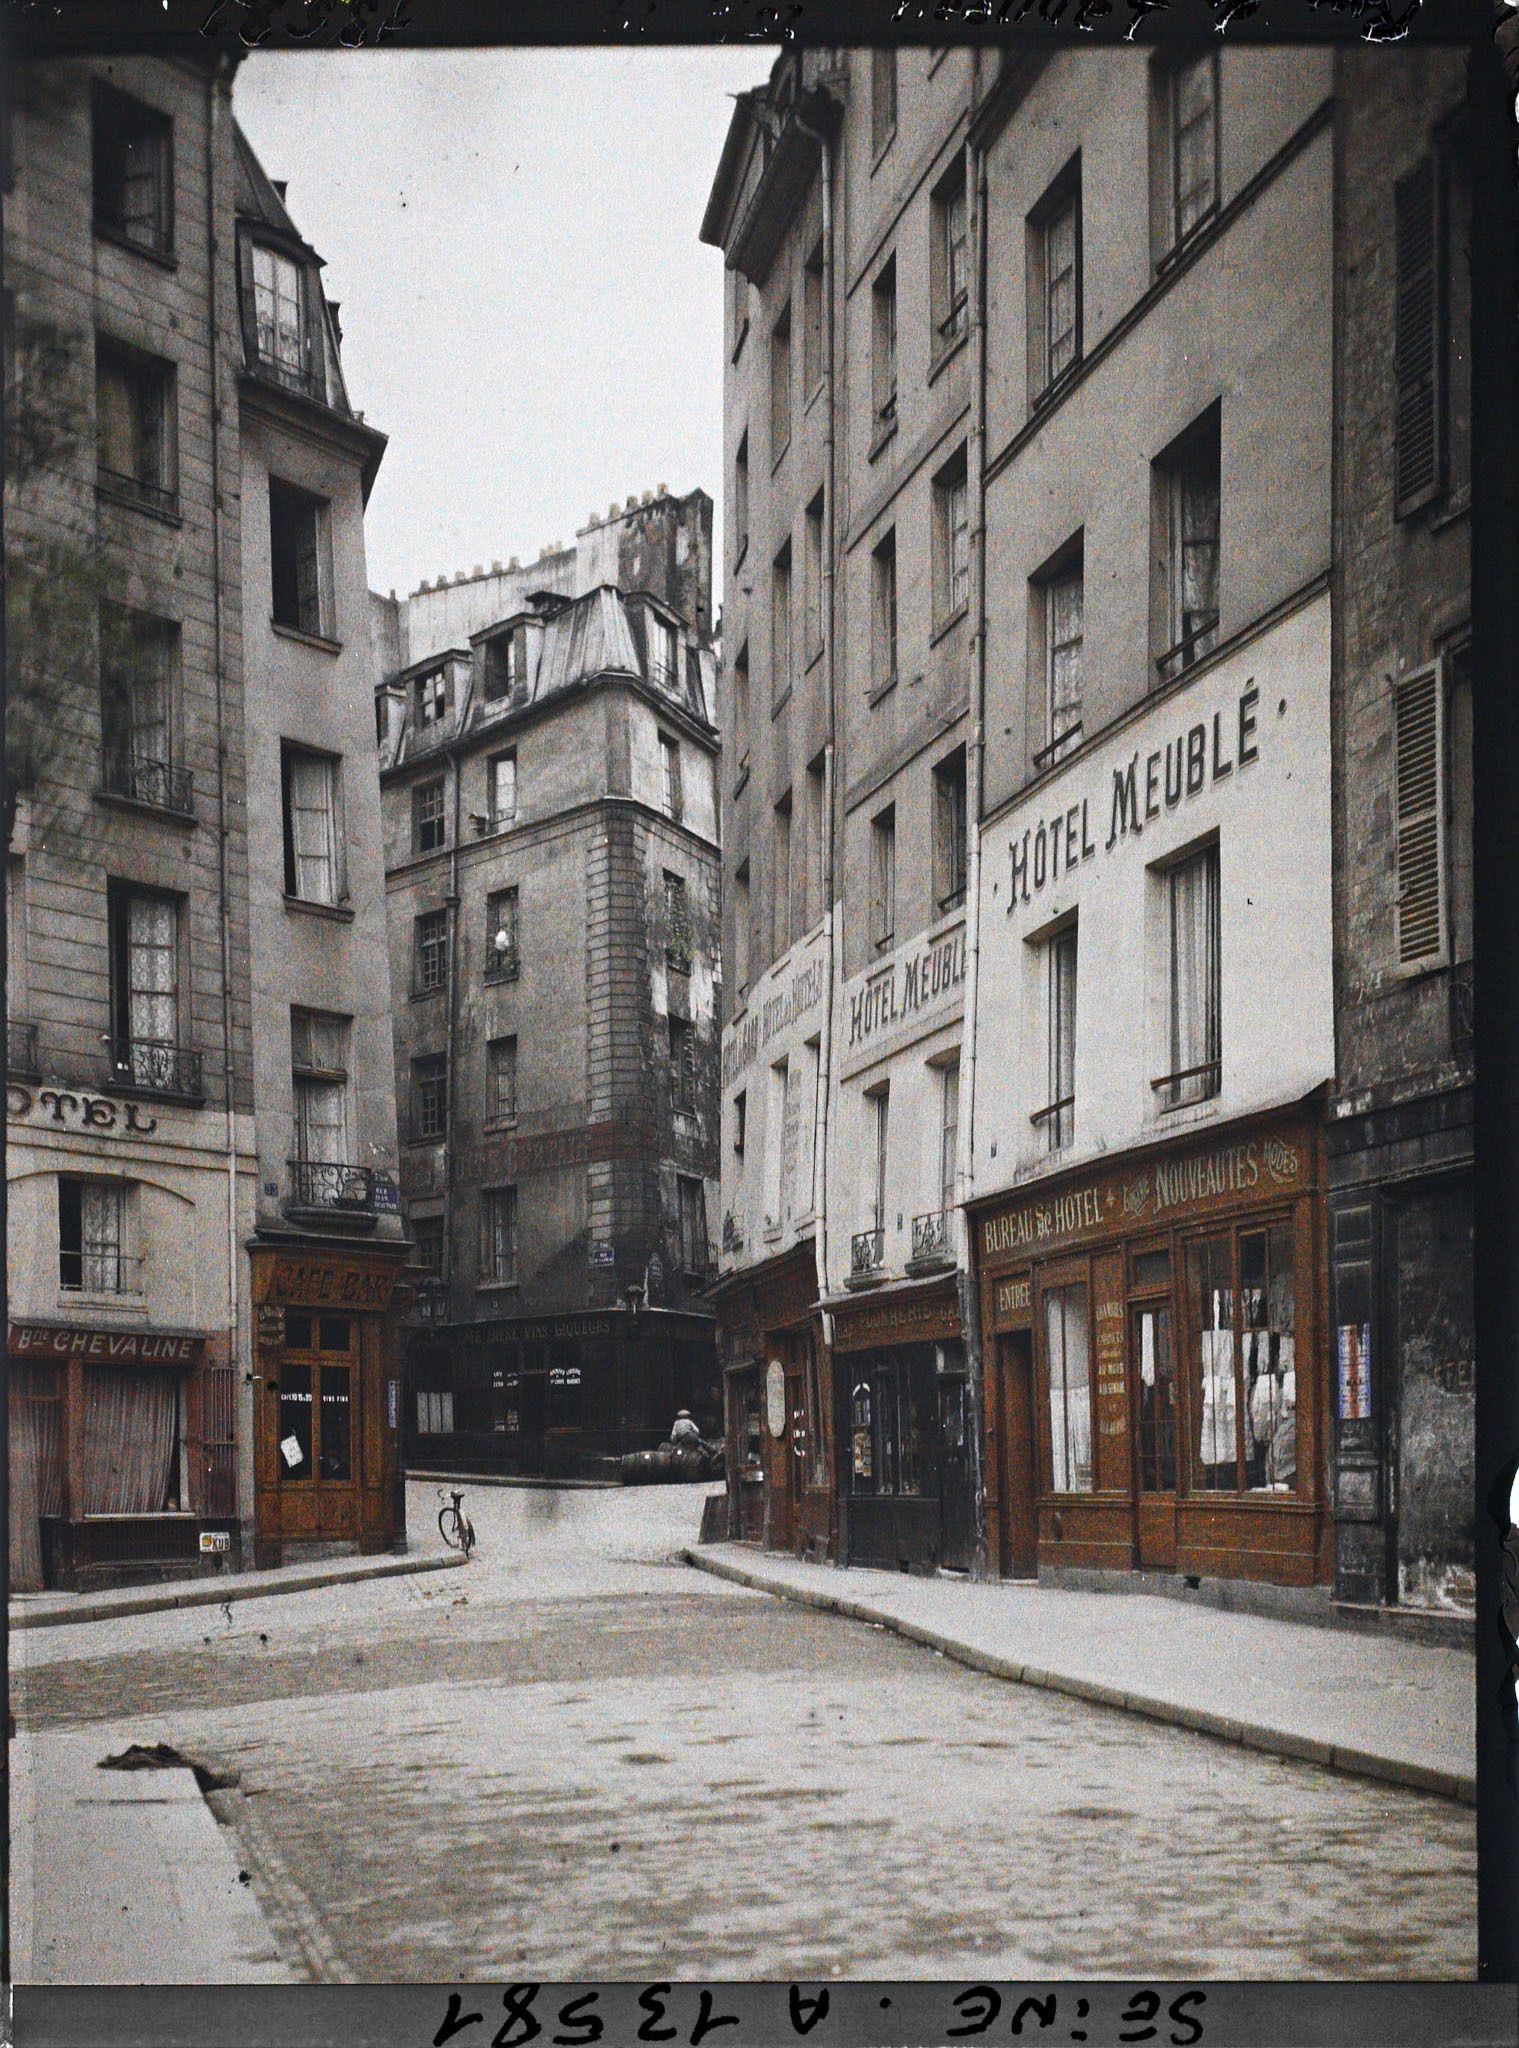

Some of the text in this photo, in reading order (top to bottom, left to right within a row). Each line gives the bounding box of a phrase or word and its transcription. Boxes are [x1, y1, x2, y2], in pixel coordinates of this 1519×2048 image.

[1006, 677, 1260, 914] HÔTEL MEUBLÉ
[984, 1208, 1034, 1255] BUREAU
[554, 1319, 610, 1338] LIQUEURS
[53, 1331, 193, 1360] CHEVALINE
[212, 1536, 230, 1553] KUB
